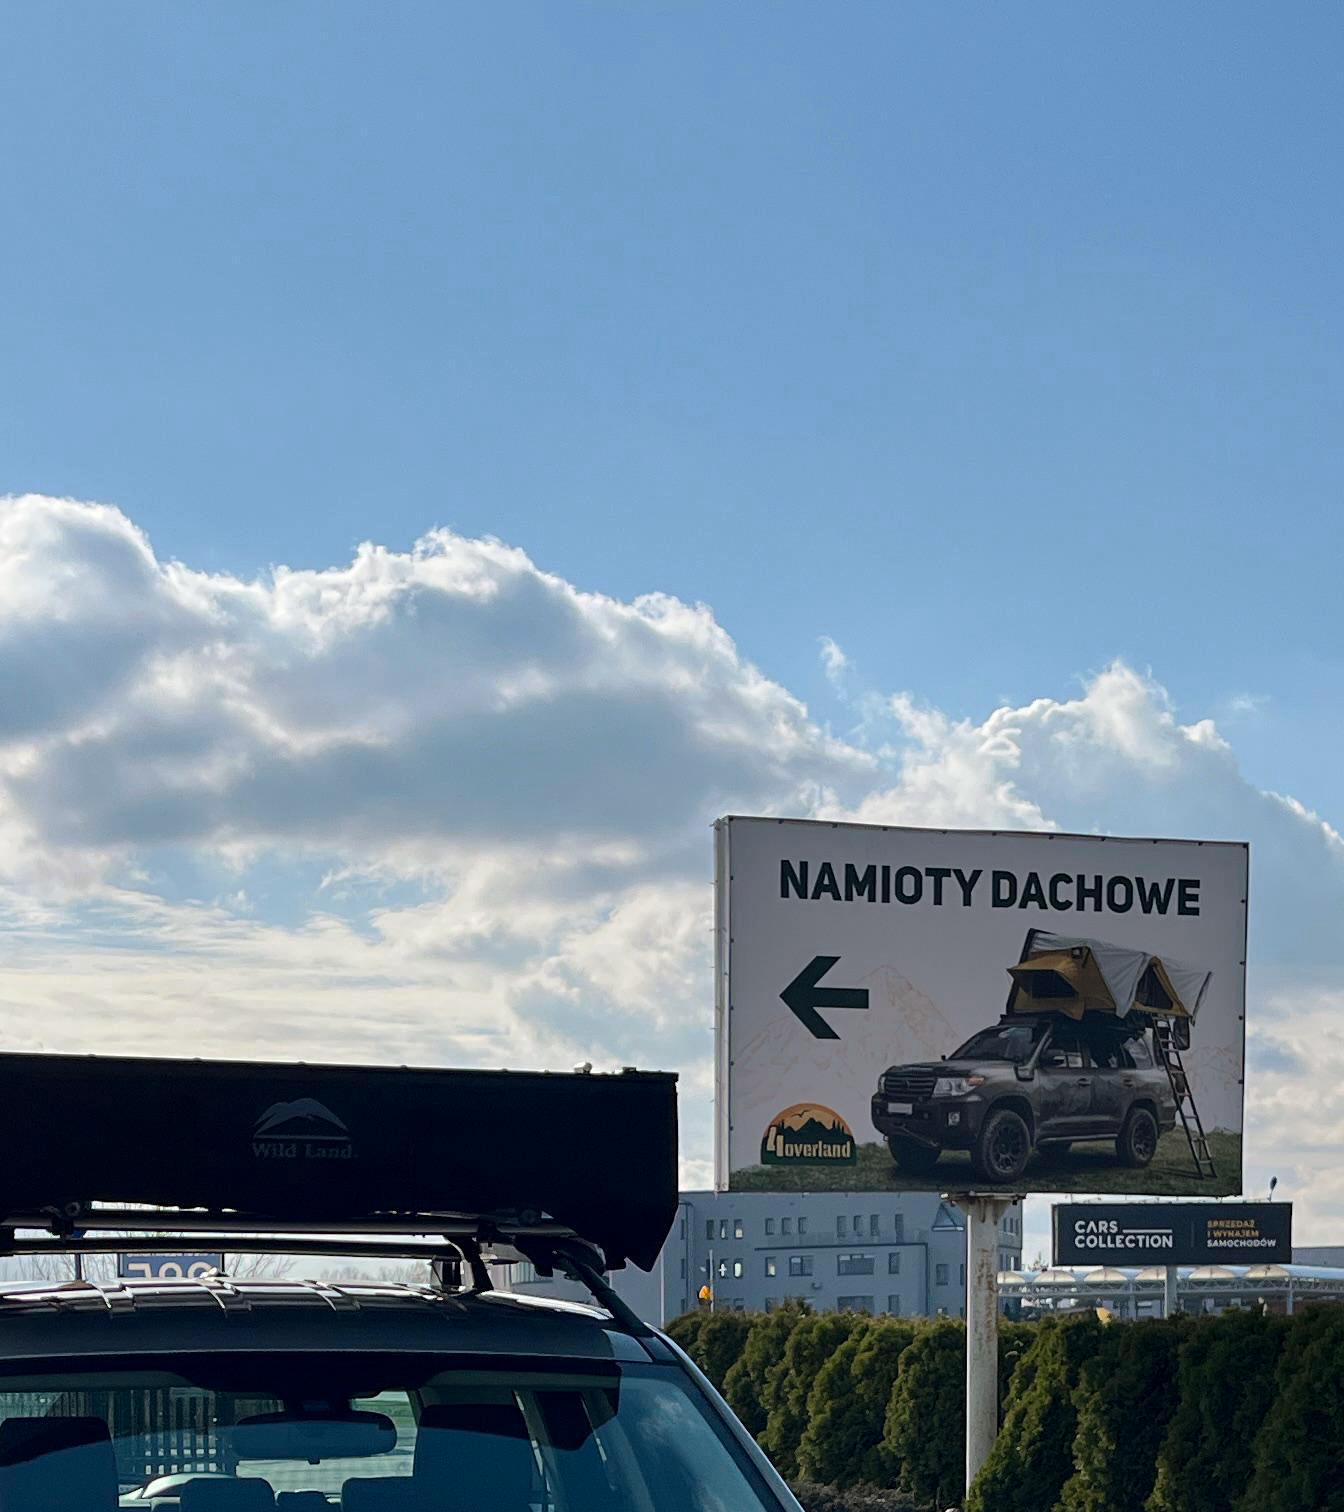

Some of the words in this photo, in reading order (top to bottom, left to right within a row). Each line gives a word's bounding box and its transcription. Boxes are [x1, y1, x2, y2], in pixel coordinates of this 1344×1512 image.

[780, 859, 983, 906] NAMIOTY
[991, 870, 1201, 916] DACHOWE
[250, 1142, 297, 1158] Wild
[1074, 1220, 1118, 1234] CARS
[1074, 1234, 1173, 1249] COLLECTION
[1207, 1237, 1277, 1248] SAMOCHODÓW
